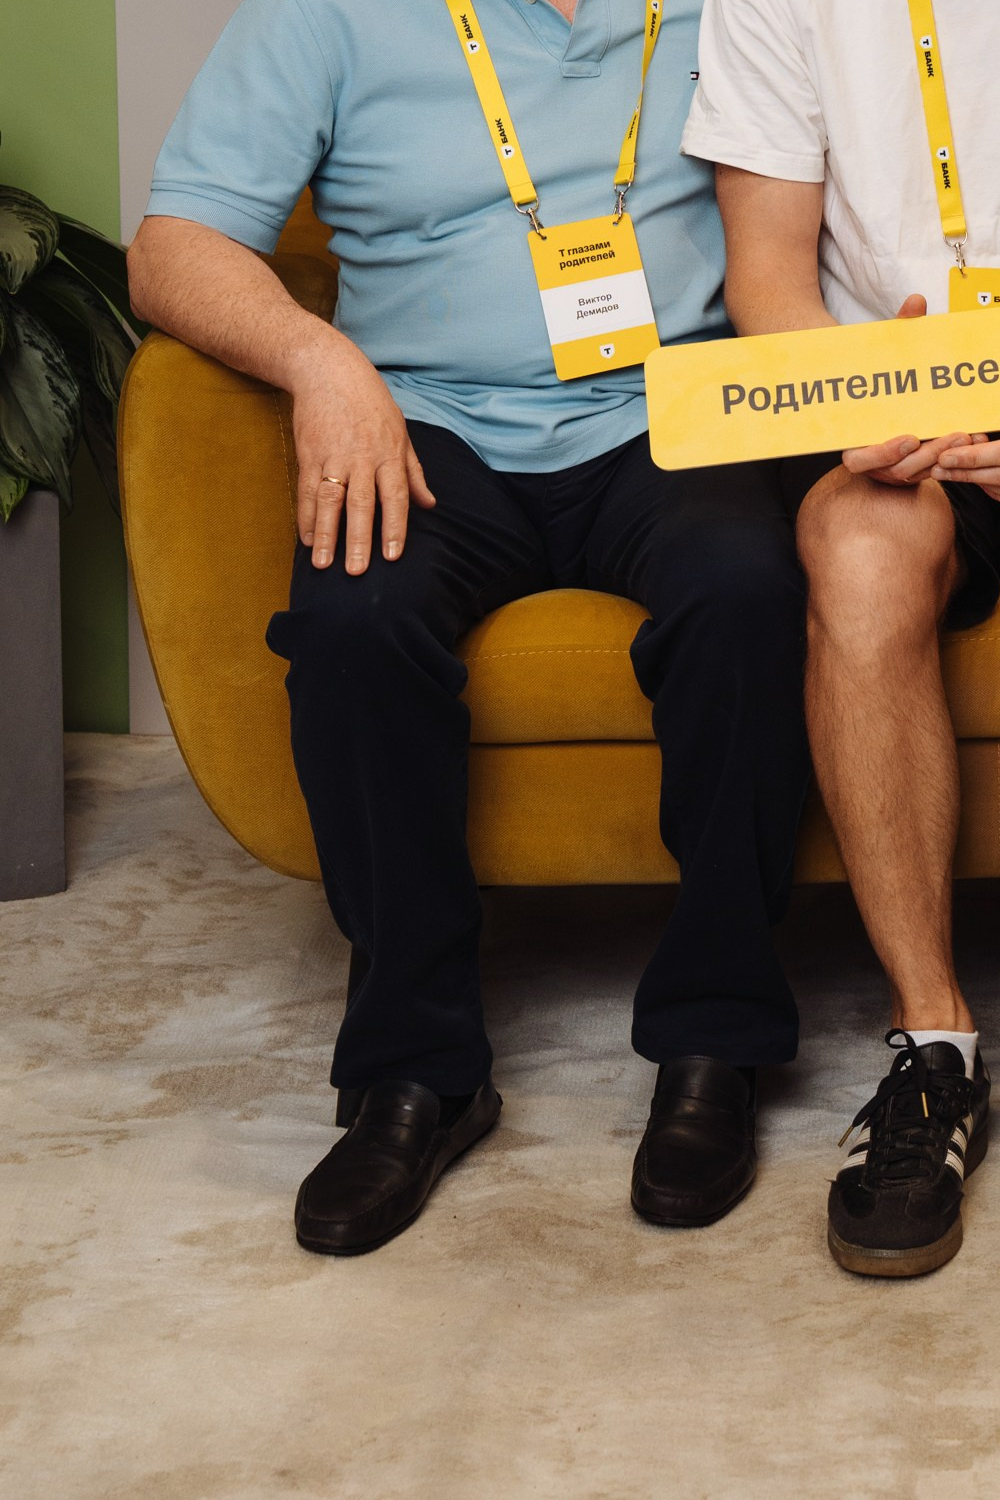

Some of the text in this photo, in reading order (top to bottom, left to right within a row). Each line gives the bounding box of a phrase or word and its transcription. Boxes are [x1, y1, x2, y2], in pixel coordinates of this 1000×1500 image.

[459, 13, 474, 40] БАНК
[924, 50, 935, 78] БАНК
[494, 117, 509, 144] БАНК
[940, 161, 952, 189] БАНК
[559, 249, 616, 271] родителей
[567, 241, 611, 256] глазами
[576, 303, 620, 320] Демидов
[578, 293, 612, 307] Виктор
[721, 368, 918, 415] Родители
[930, 358, 1000, 391] все
